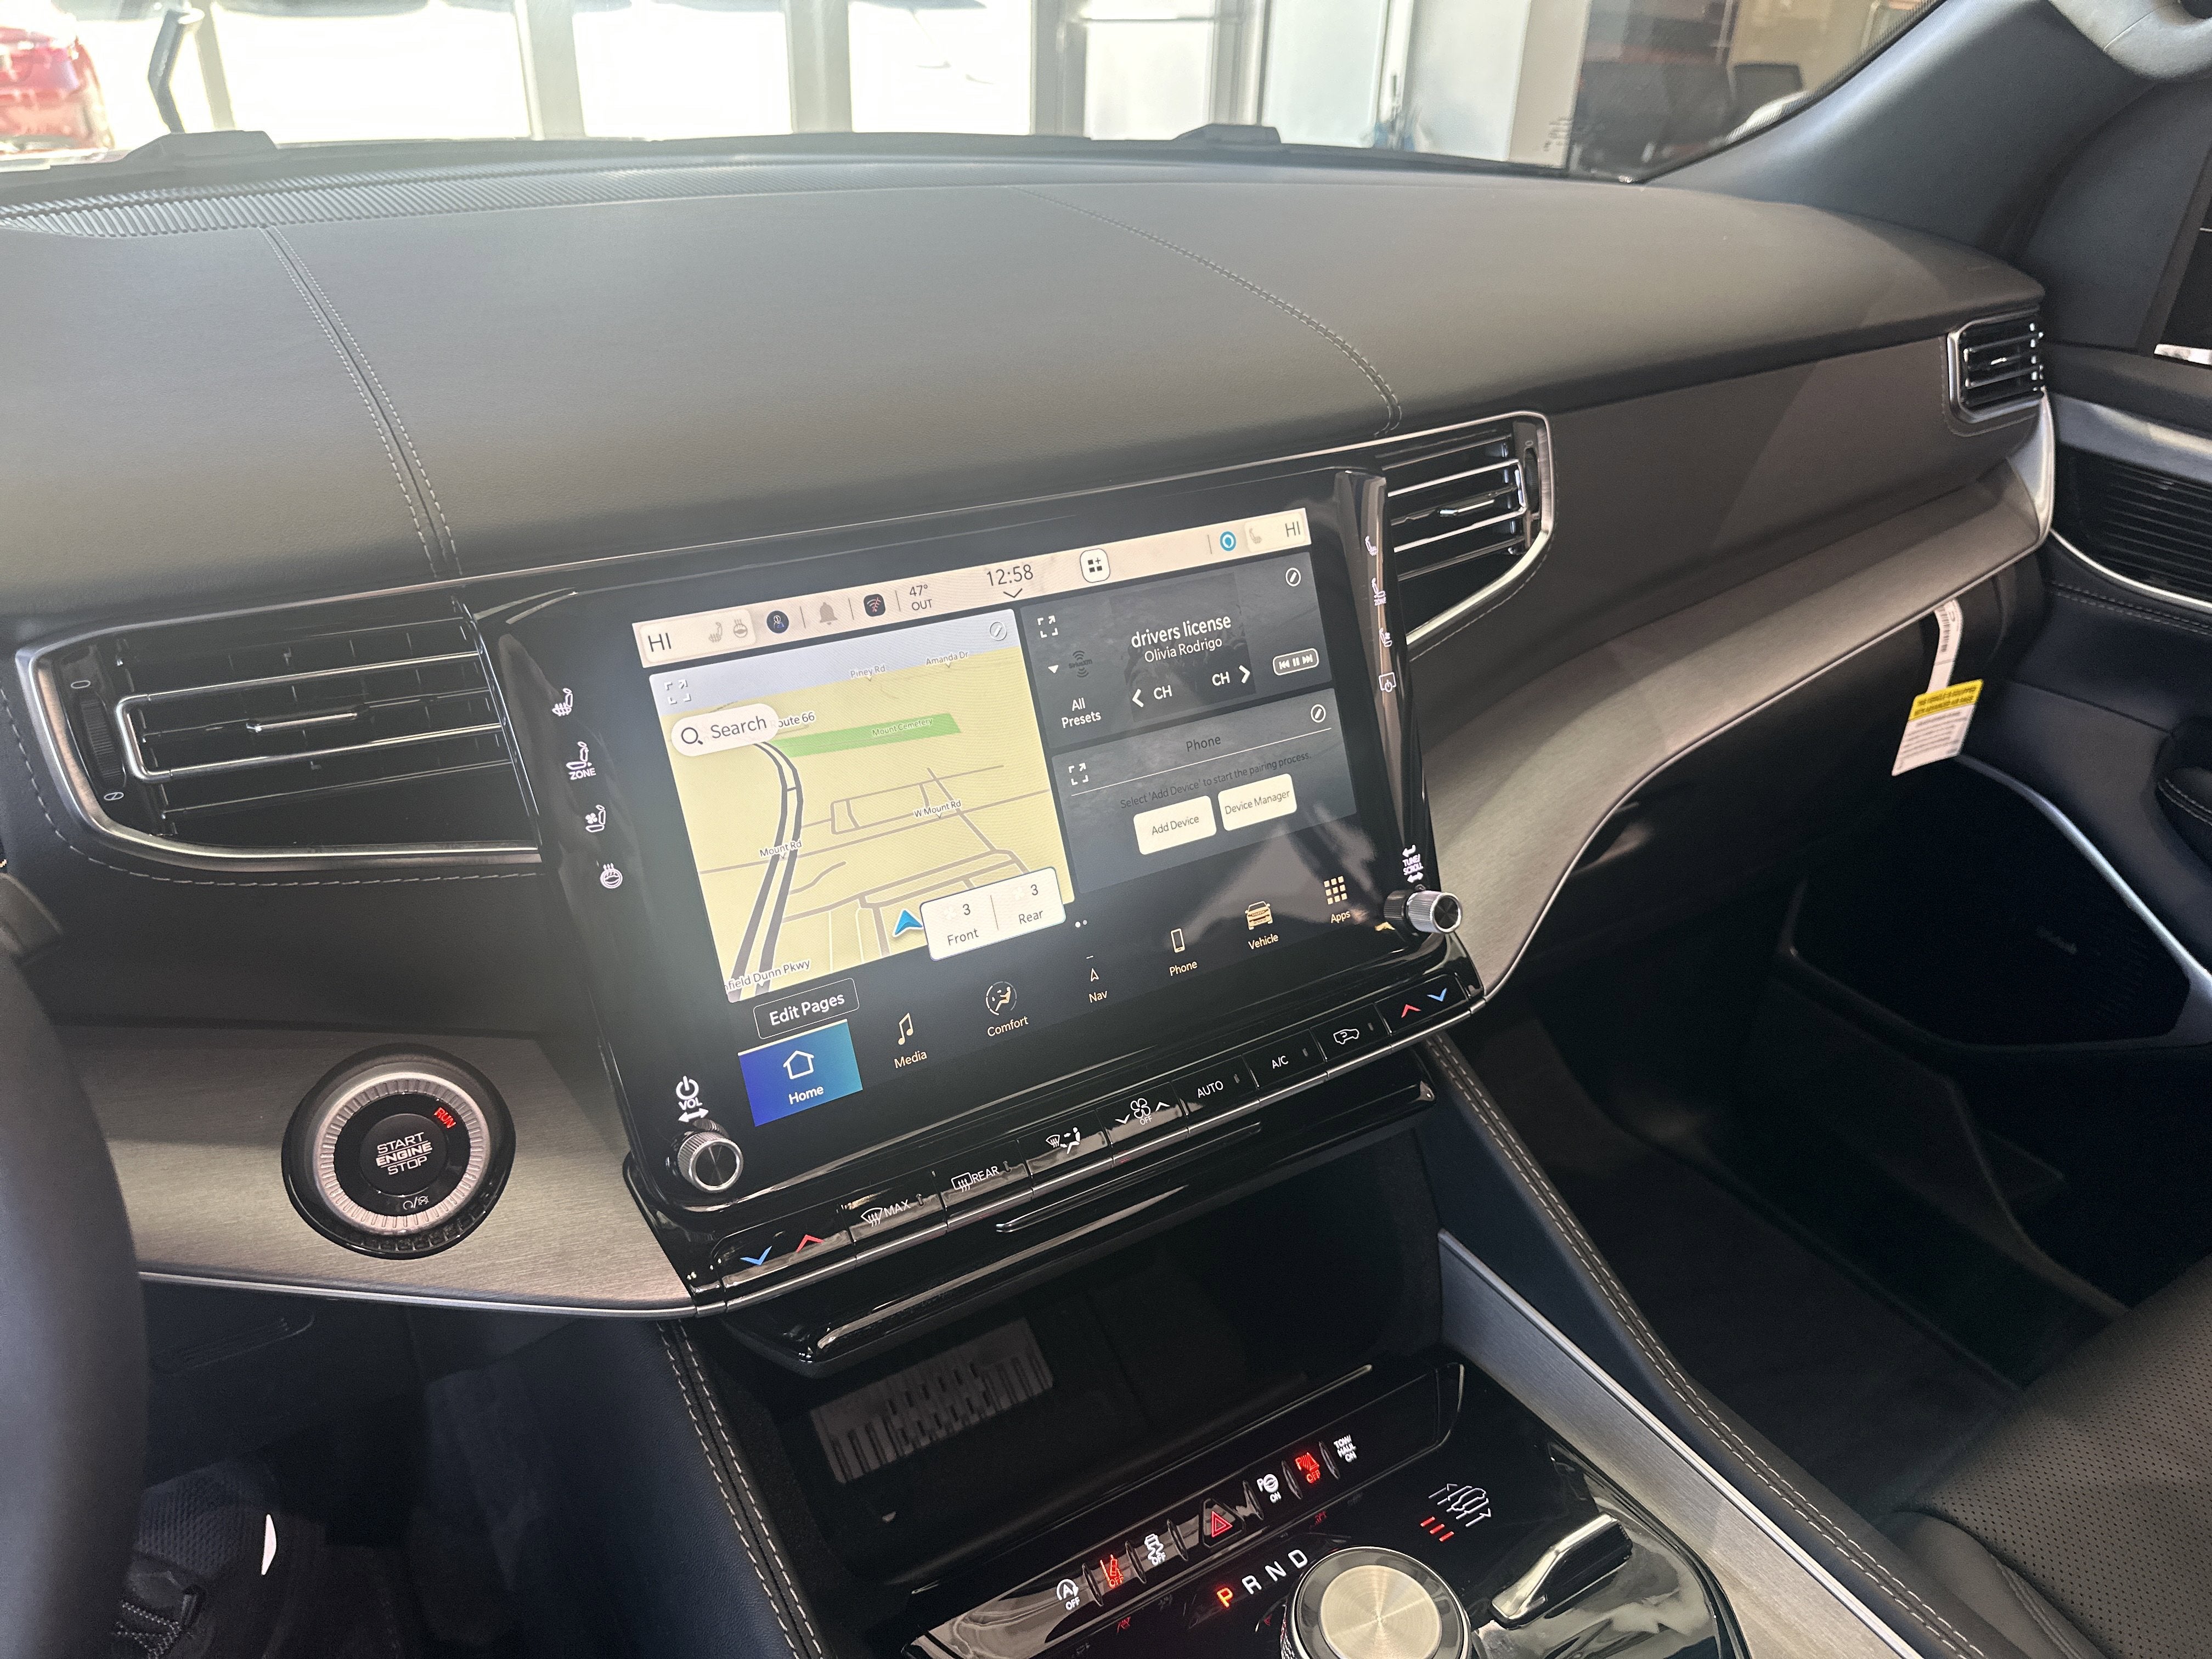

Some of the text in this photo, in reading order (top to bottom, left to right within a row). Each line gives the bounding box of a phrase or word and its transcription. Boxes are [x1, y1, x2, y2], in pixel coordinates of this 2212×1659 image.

[1285, 521, 1301, 537] HI
[987, 565, 1033, 586] 12:58
[910, 584, 928, 596] 47°
[912, 599, 932, 611] OUT
[1131, 616, 1231, 648] drivers license
[648, 632, 672, 652] HI
[1145, 638, 1222, 663] Olivia Rodrigo
[926, 654, 957, 665] Amanda
[850, 666, 873, 679] Piney
[1212, 672, 1230, 686] CH
[1153, 685, 1172, 699] CH
[1072, 698, 1085, 711] All
[802, 712, 815, 723] 66
[1062, 711, 1101, 728] Presets
[710, 716, 767, 738] Search
[872, 718, 933, 737] Mount Cemetery
[1186, 736, 1221, 752] Phone
[569, 768, 596, 780] ZONE
[1120, 752, 1312, 809] Select 'Add Device' to start the pairing process.
[914, 800, 961, 817] W Mount Rd
[1225, 791, 1290, 814] Device Manager
[1152, 815, 1199, 835] Add Device
[760, 840, 802, 856] Mount Rd
[1403, 862, 1424, 875] SCROLL
[1031, 884, 1039, 896] 3
[963, 904, 971, 915] 3
[1019, 910, 1043, 924] Rear
[1331, 910, 1351, 924] Apps
[947, 928, 979, 946] Front
[1248, 933, 1278, 950] Vehicle
[753, 969, 781, 982] Dunn
[783, 961, 810, 974] Pkwy
[1169, 960, 1198, 976] Phone
[1088, 989, 1108, 1003] Nav
[769, 992, 845, 1026] Edit Pages
[987, 1015, 1029, 1037] Comfort
[894, 1049, 927, 1069] Media
[1271, 1055, 1289, 1069] A/C
[788, 1085, 824, 1104] Home
[1197, 1080, 1224, 1098] AUTO
[679, 1098, 703, 1110] VOL
[433, 1107, 456, 1130] RUN
[1139, 1115, 1153, 1125] OFF
[377, 1132, 425, 1153] START
[376, 1141, 433, 1166] ENGINE
[387, 1155, 428, 1176] STOP
[971, 1165, 1000, 1184] REAR
[883, 1199, 911, 1217] MAX
[1337, 1443, 1357, 1458] HAUL
[1345, 1451, 1357, 1463] ON
[1306, 1469, 1321, 1484] OFF
[1269, 1491, 1282, 1504] ON
[1151, 1551, 1166, 1566] OFF
[1108, 1575, 1124, 1589] OFF
[1216, 1549, 1308, 1609] P R N D
[1065, 1596, 1080, 1611] OFF
